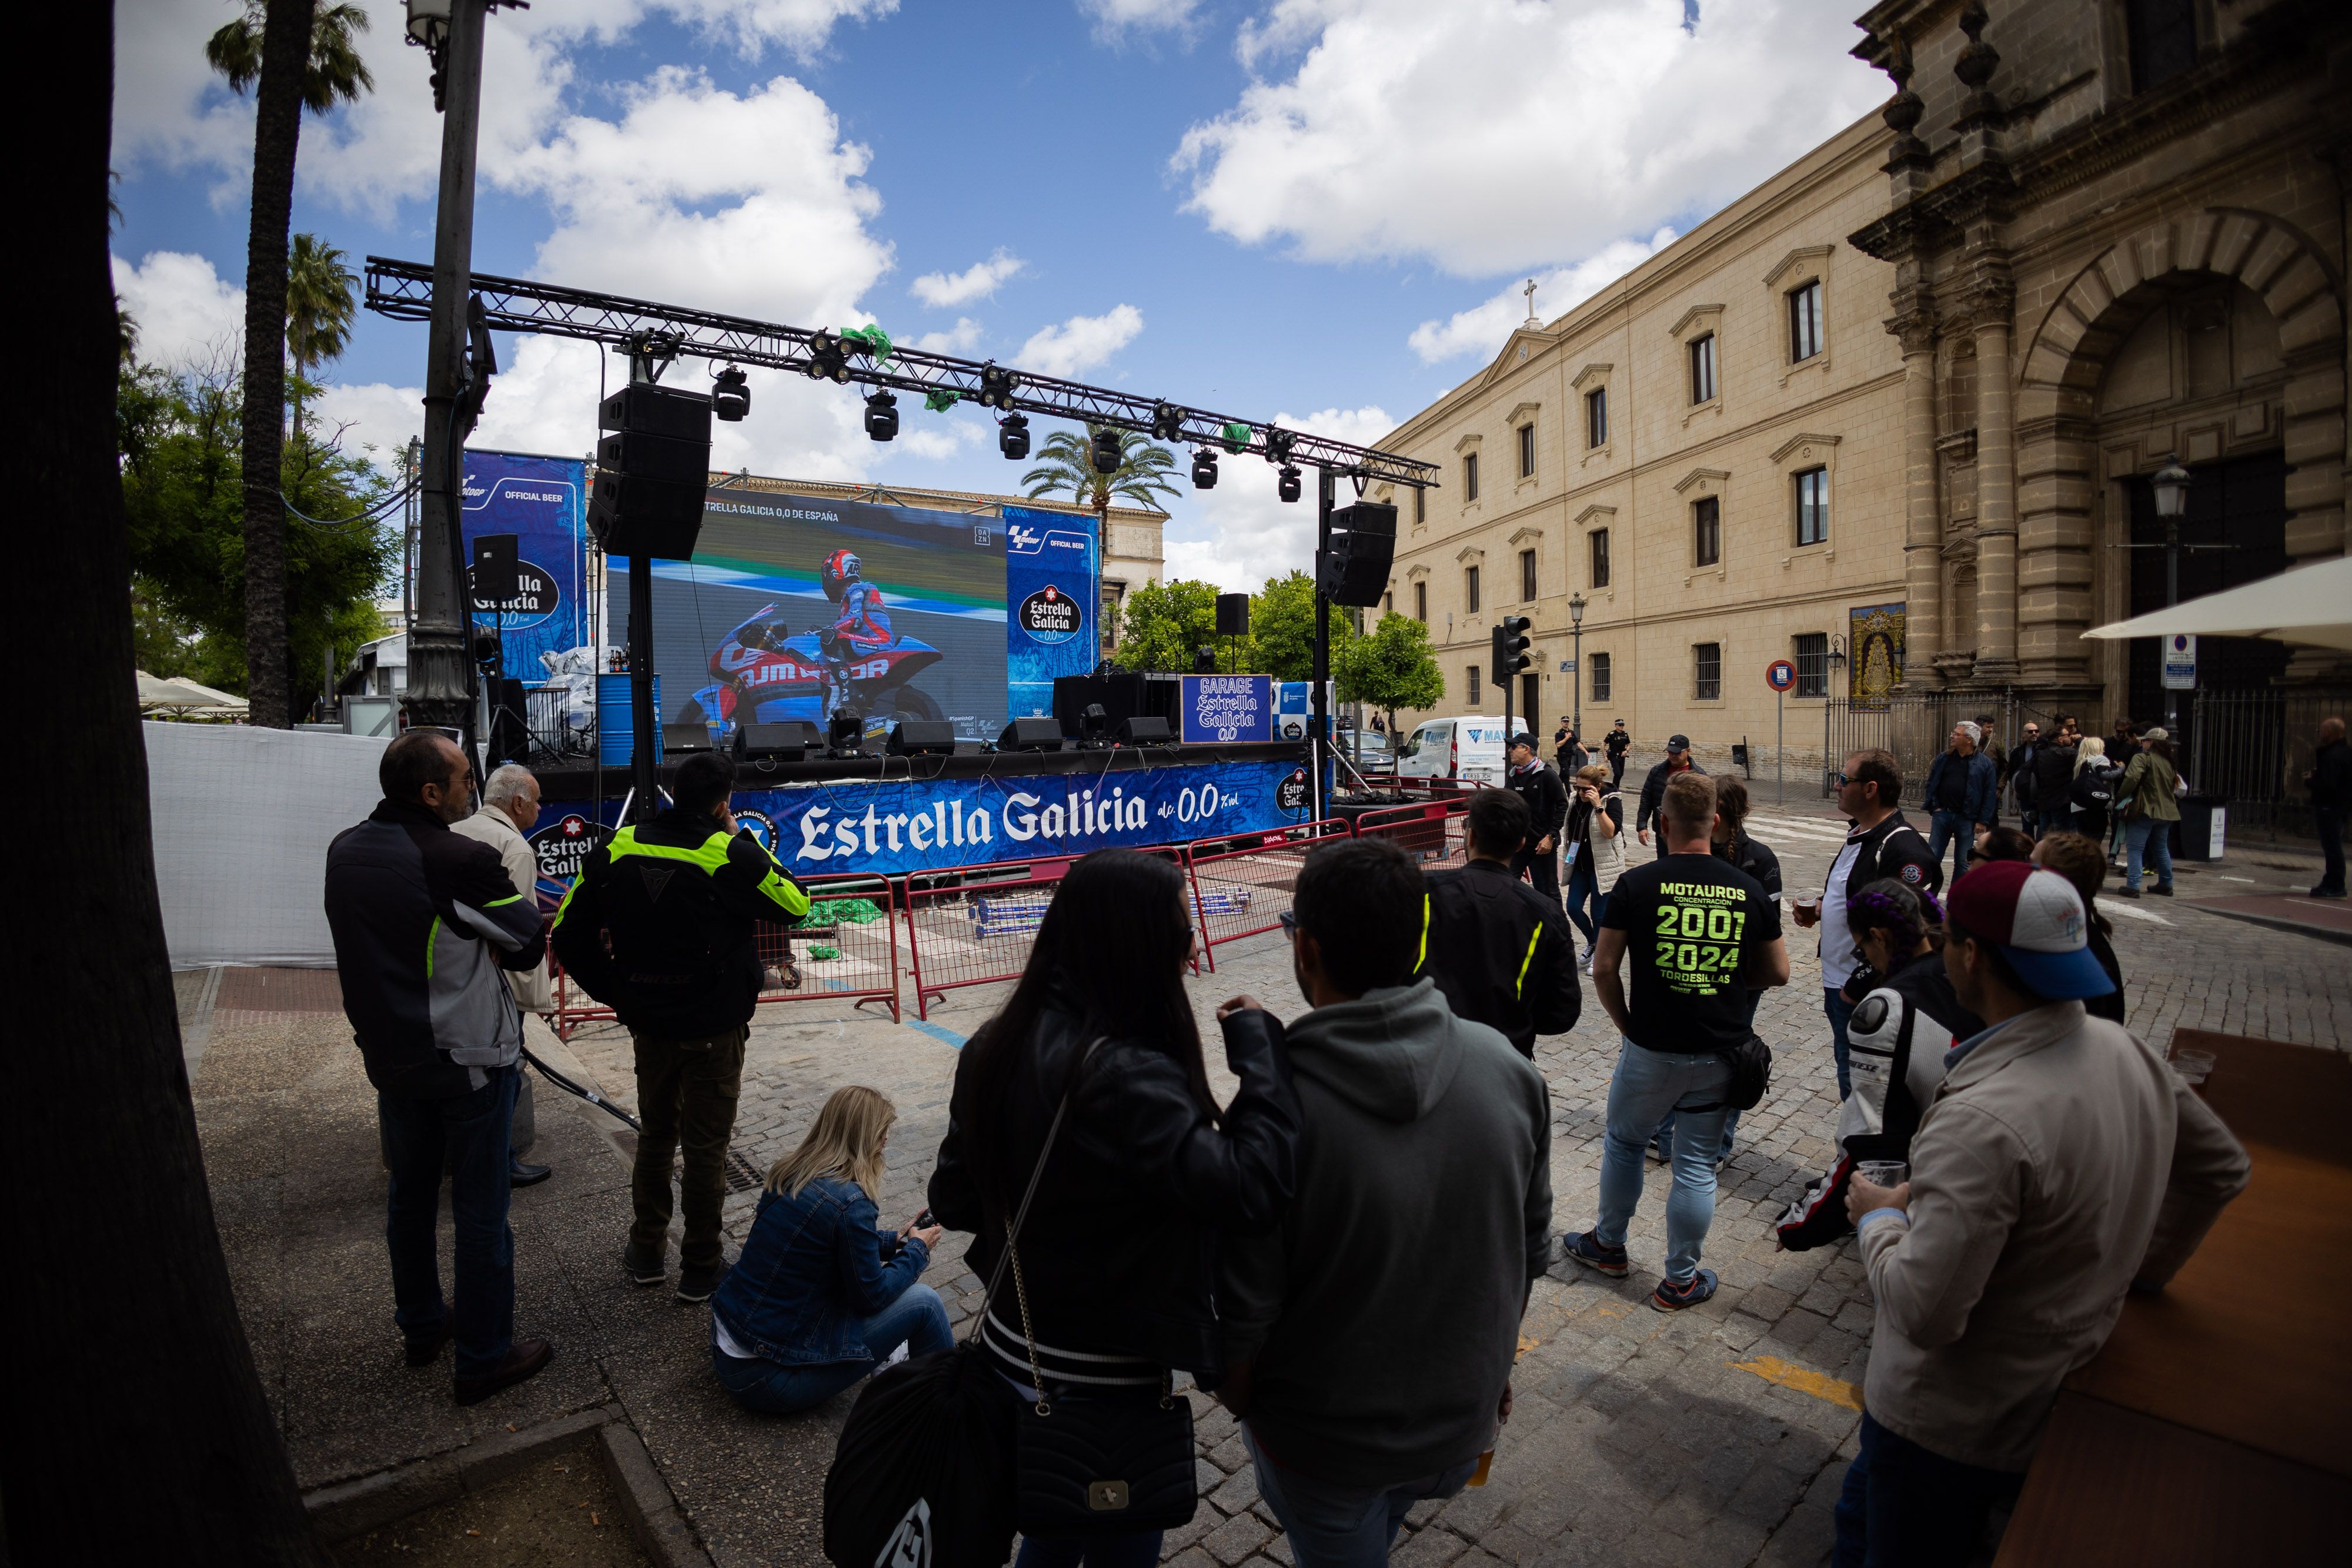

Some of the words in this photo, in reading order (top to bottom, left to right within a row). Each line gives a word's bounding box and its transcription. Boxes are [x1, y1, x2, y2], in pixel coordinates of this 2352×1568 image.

[505, 491, 541, 501] OFFICIAL
[542, 493, 563, 503] BEER
[704, 502, 738, 513] TRELLA
[740, 504, 774, 517] GALICIA
[776, 508, 790, 519] 0,0
[792, 509, 804, 519] DE
[805, 510, 838, 522] ESPAÑA
[1050, 540, 1072, 549] OFFICIAL
[1030, 601, 1072, 616] Estrella
[1031, 615, 1070, 630] Galicia
[1044, 630, 1057, 641] 0,0
[1200, 678, 1253, 694] GARAGE
[1197, 694, 1257, 711] Estrella
[1199, 711, 1255, 727] Galicia
[966, 728, 974, 736] Q2
[1218, 727, 1237, 741] 0,0
[743, 811, 766, 822] GALICIA
[796, 799, 994, 862] Estrella
[1003, 787, 1148, 841] Galicia
[1177, 783, 1218, 823] 0,0
[540, 855, 582, 876] Gali
[1660, 882, 1746, 901] MOTAUROS
[1673, 896, 1732, 906] CONCENTRACIÓN
[1656, 905, 1746, 941] 2001
[1655, 942, 1739, 972] 2024
[1660, 969, 1730, 984] TORDESILLAS
